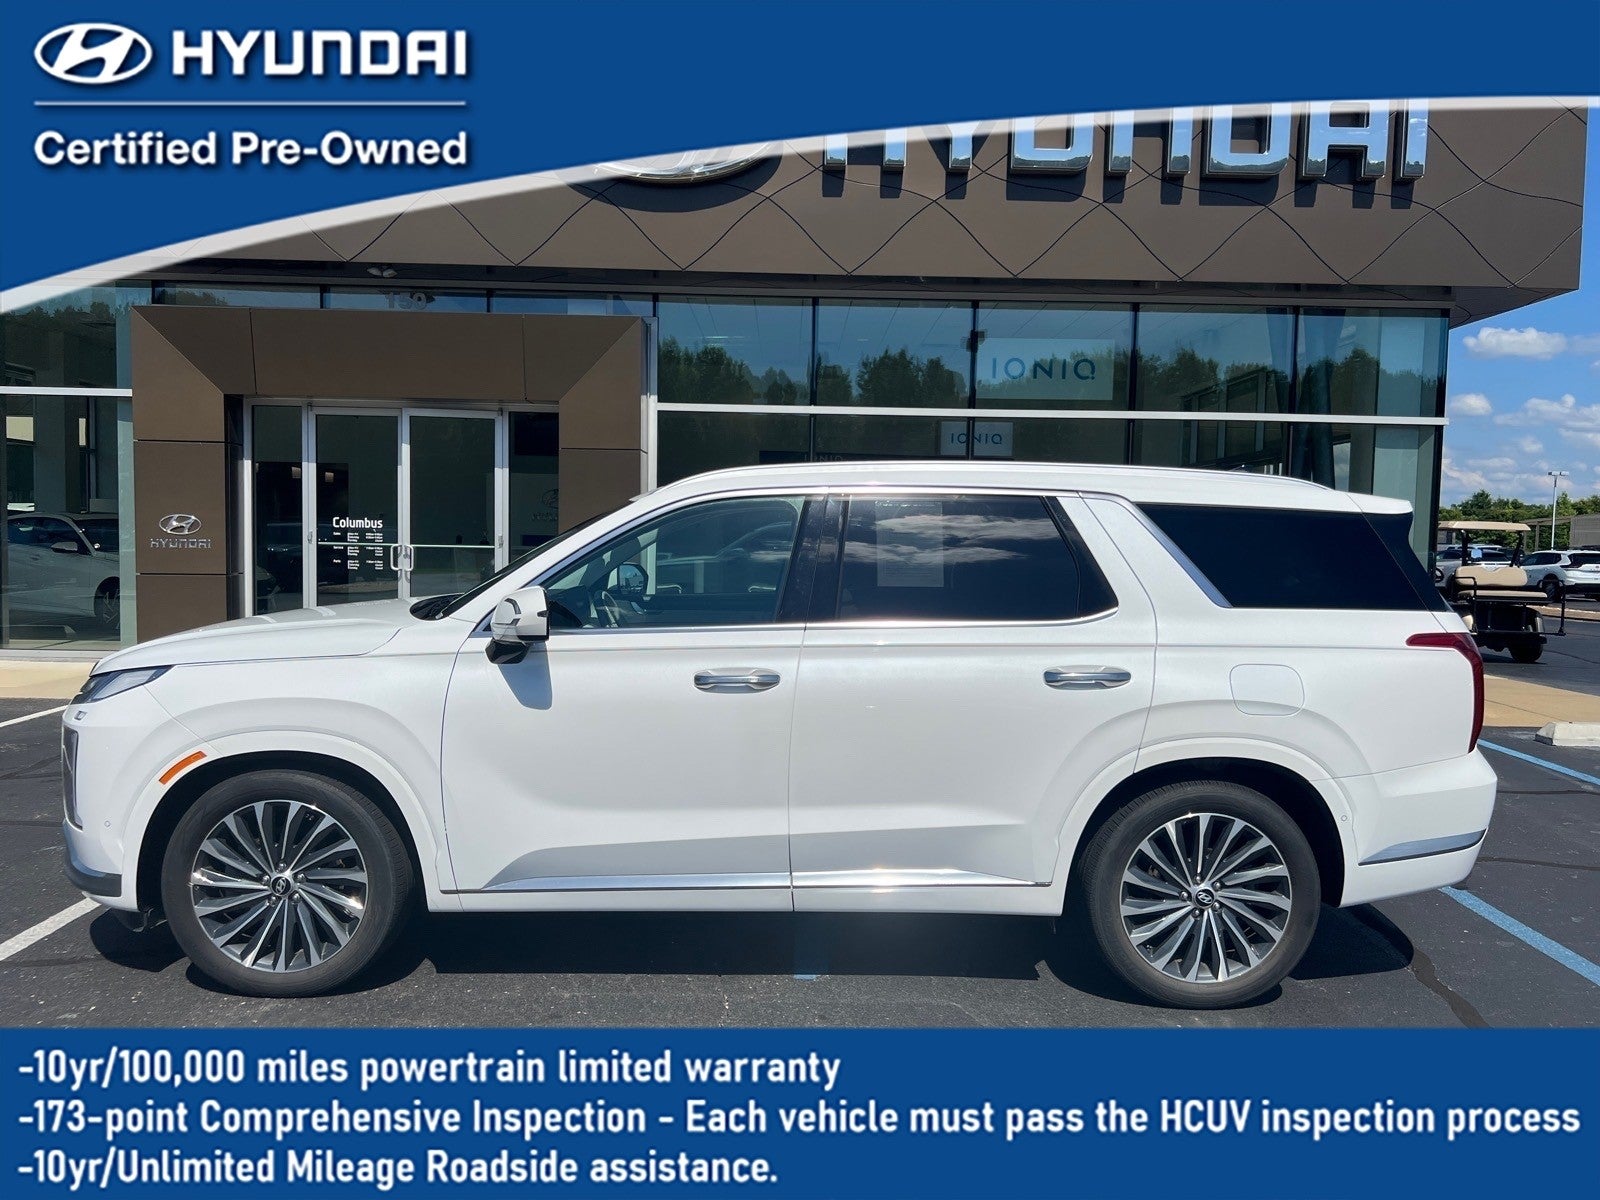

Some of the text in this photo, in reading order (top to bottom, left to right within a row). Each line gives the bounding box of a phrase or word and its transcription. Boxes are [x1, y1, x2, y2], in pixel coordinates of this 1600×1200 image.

[992, 357, 1096, 380] IONIQ
[951, 433, 1003, 444] IONIQ
[332, 516, 383, 529] Columbus
[150, 538, 211, 549] HYUNDAI
